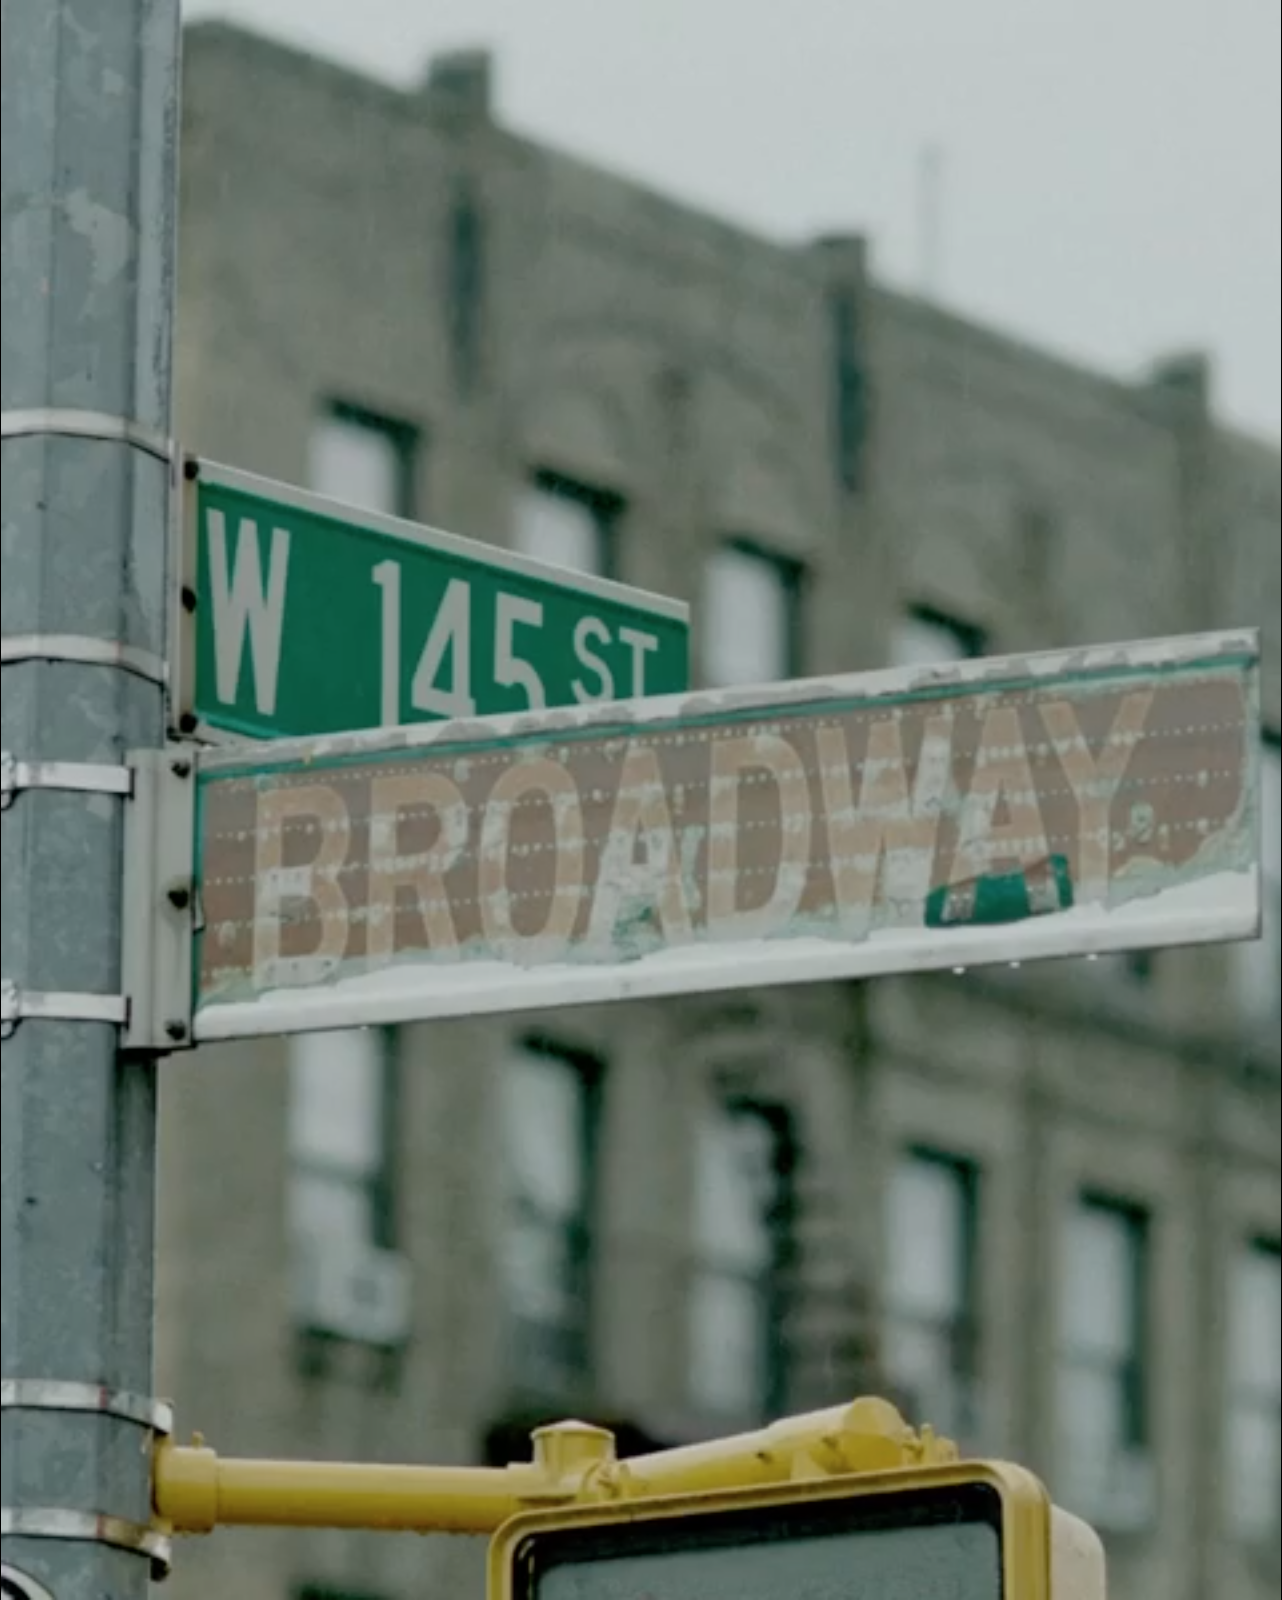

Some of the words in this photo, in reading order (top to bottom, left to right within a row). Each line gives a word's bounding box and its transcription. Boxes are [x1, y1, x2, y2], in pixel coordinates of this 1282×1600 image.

[207, 508, 290, 716] W
[372, 560, 546, 728] 145
[572, 616, 658, 702] ST
[252, 693, 1150, 984] BROADWAY
